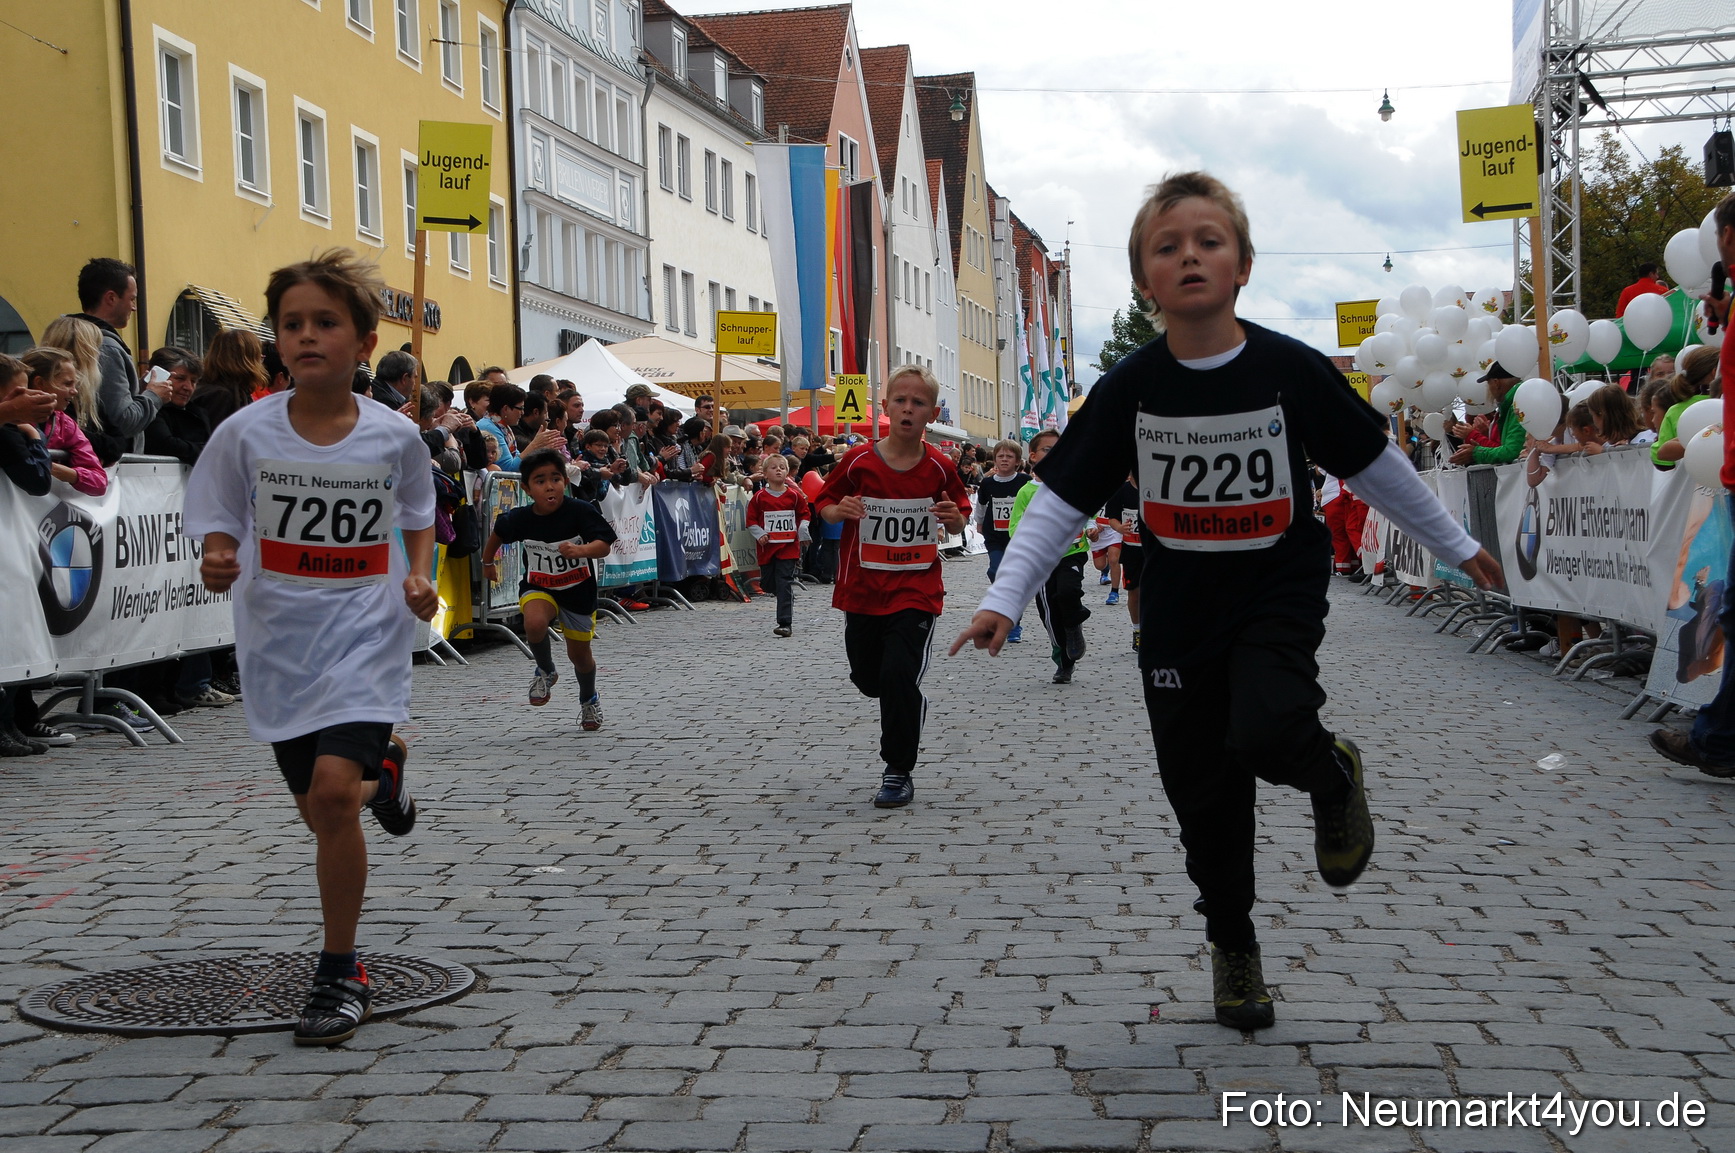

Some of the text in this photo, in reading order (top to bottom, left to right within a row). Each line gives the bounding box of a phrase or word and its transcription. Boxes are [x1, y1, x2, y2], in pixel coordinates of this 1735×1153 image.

[1461, 135, 1533, 158] Jugend-
[421, 150, 490, 174] Jugend-
[1482, 156, 1516, 177] lauf
[439, 173, 471, 190] lauf
[720, 322, 772, 335] Schnupper-
[1358, 325, 1375, 335] lauf
[737, 336, 755, 345] lauf
[838, 375, 864, 385] Block
[1347, 374, 1368, 385] lock
[841, 389, 859, 412] A
[1138, 426, 1263, 445] PARTL Neumarkt
[260, 471, 379, 490] PARTL Neumarkt
[1151, 448, 1274, 503] 7229
[272, 494, 383, 544] 7262
[889, 506, 927, 514] Neumarkt
[1545, 496, 1577, 537] BMW
[868, 515, 930, 543] 7094
[1173, 511, 1260, 535] Michael
[115, 513, 161, 569] BMW
[298, 551, 355, 573] Anian
[886, 549, 912, 562] Luca
[1545, 548, 1581, 582] Weniger
[531, 570, 586, 586] Karl Emanuel
[110, 583, 162, 624] Weniger
